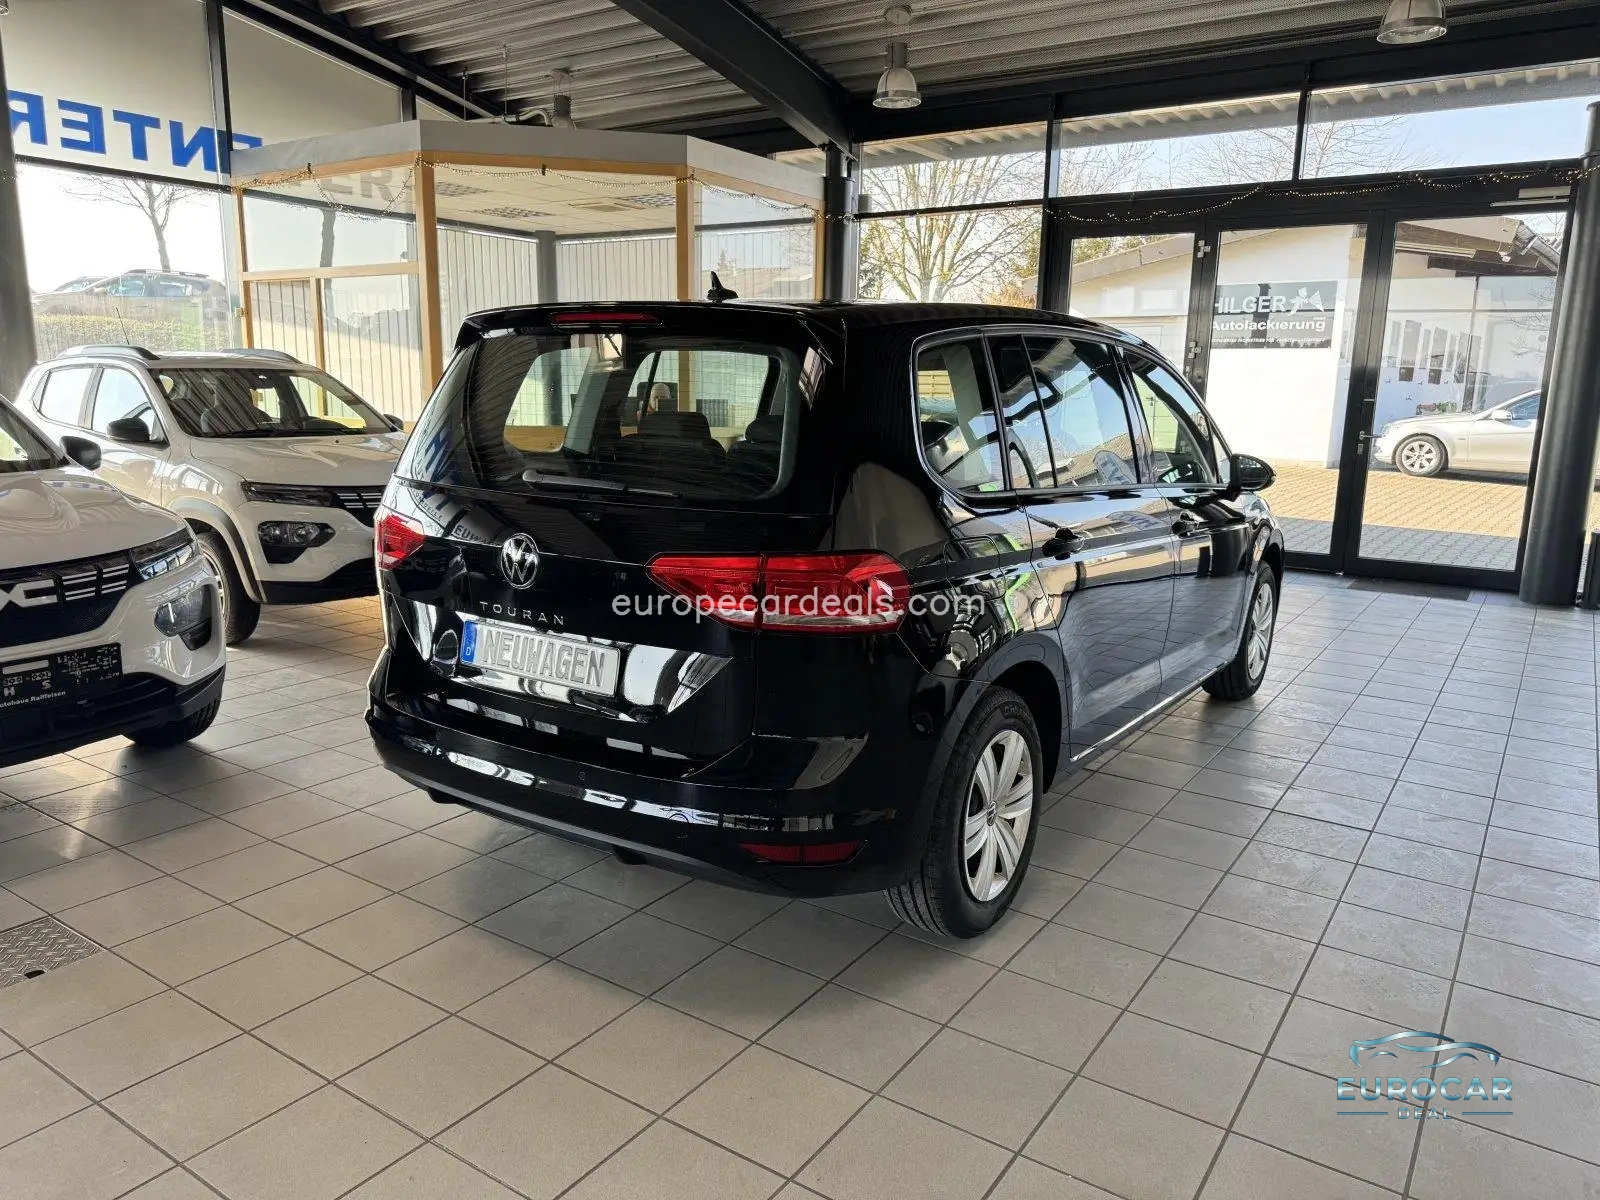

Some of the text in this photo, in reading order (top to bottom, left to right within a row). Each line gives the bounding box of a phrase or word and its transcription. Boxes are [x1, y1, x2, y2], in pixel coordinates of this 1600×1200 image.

[1213, 319, 1326, 332] Autolackierung
[479, 601, 564, 626] TOURAN
[483, 627, 606, 688] NEUWAGEN
[0, 698, 29, 708] utohaus
